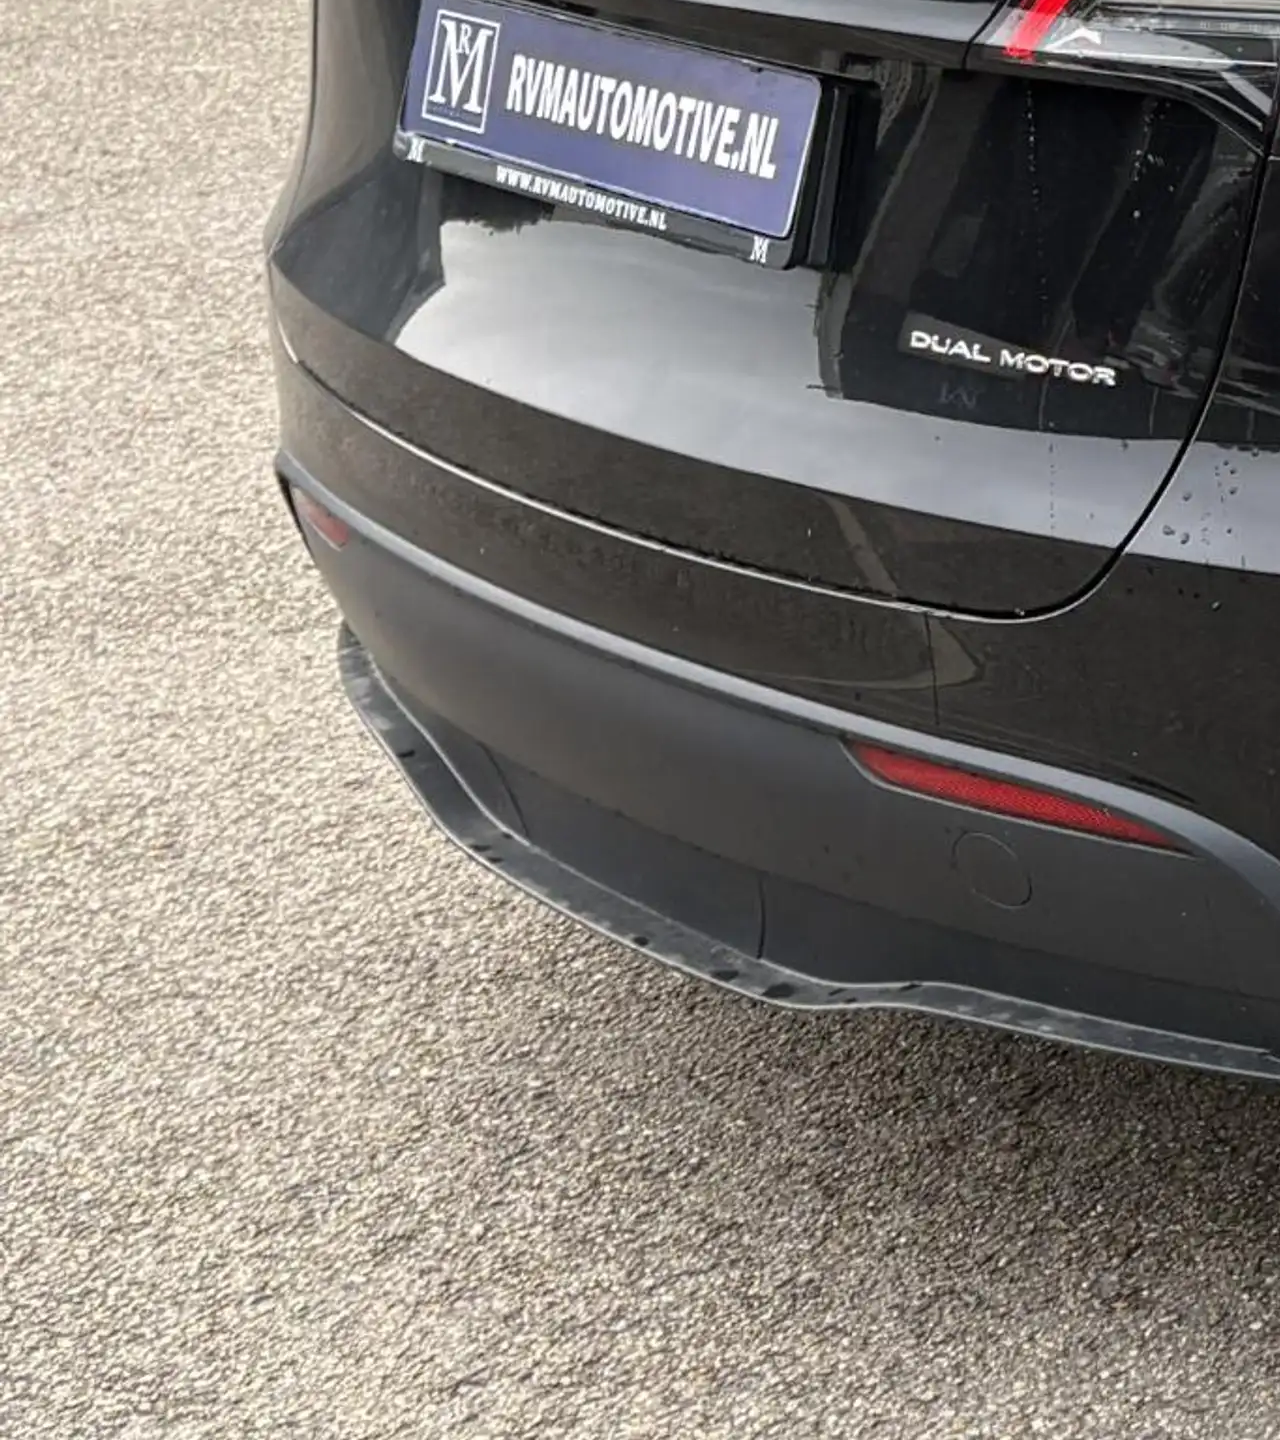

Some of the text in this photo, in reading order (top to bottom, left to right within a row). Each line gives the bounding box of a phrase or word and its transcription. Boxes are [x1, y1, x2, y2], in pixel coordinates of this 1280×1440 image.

[506, 54, 779, 179] RVMAUTOMOTIVE.NL
[496, 165, 668, 231] WWW.RVMAUTOMOTIVE.NL
[910, 330, 1117, 387] DUAL MOTOR
